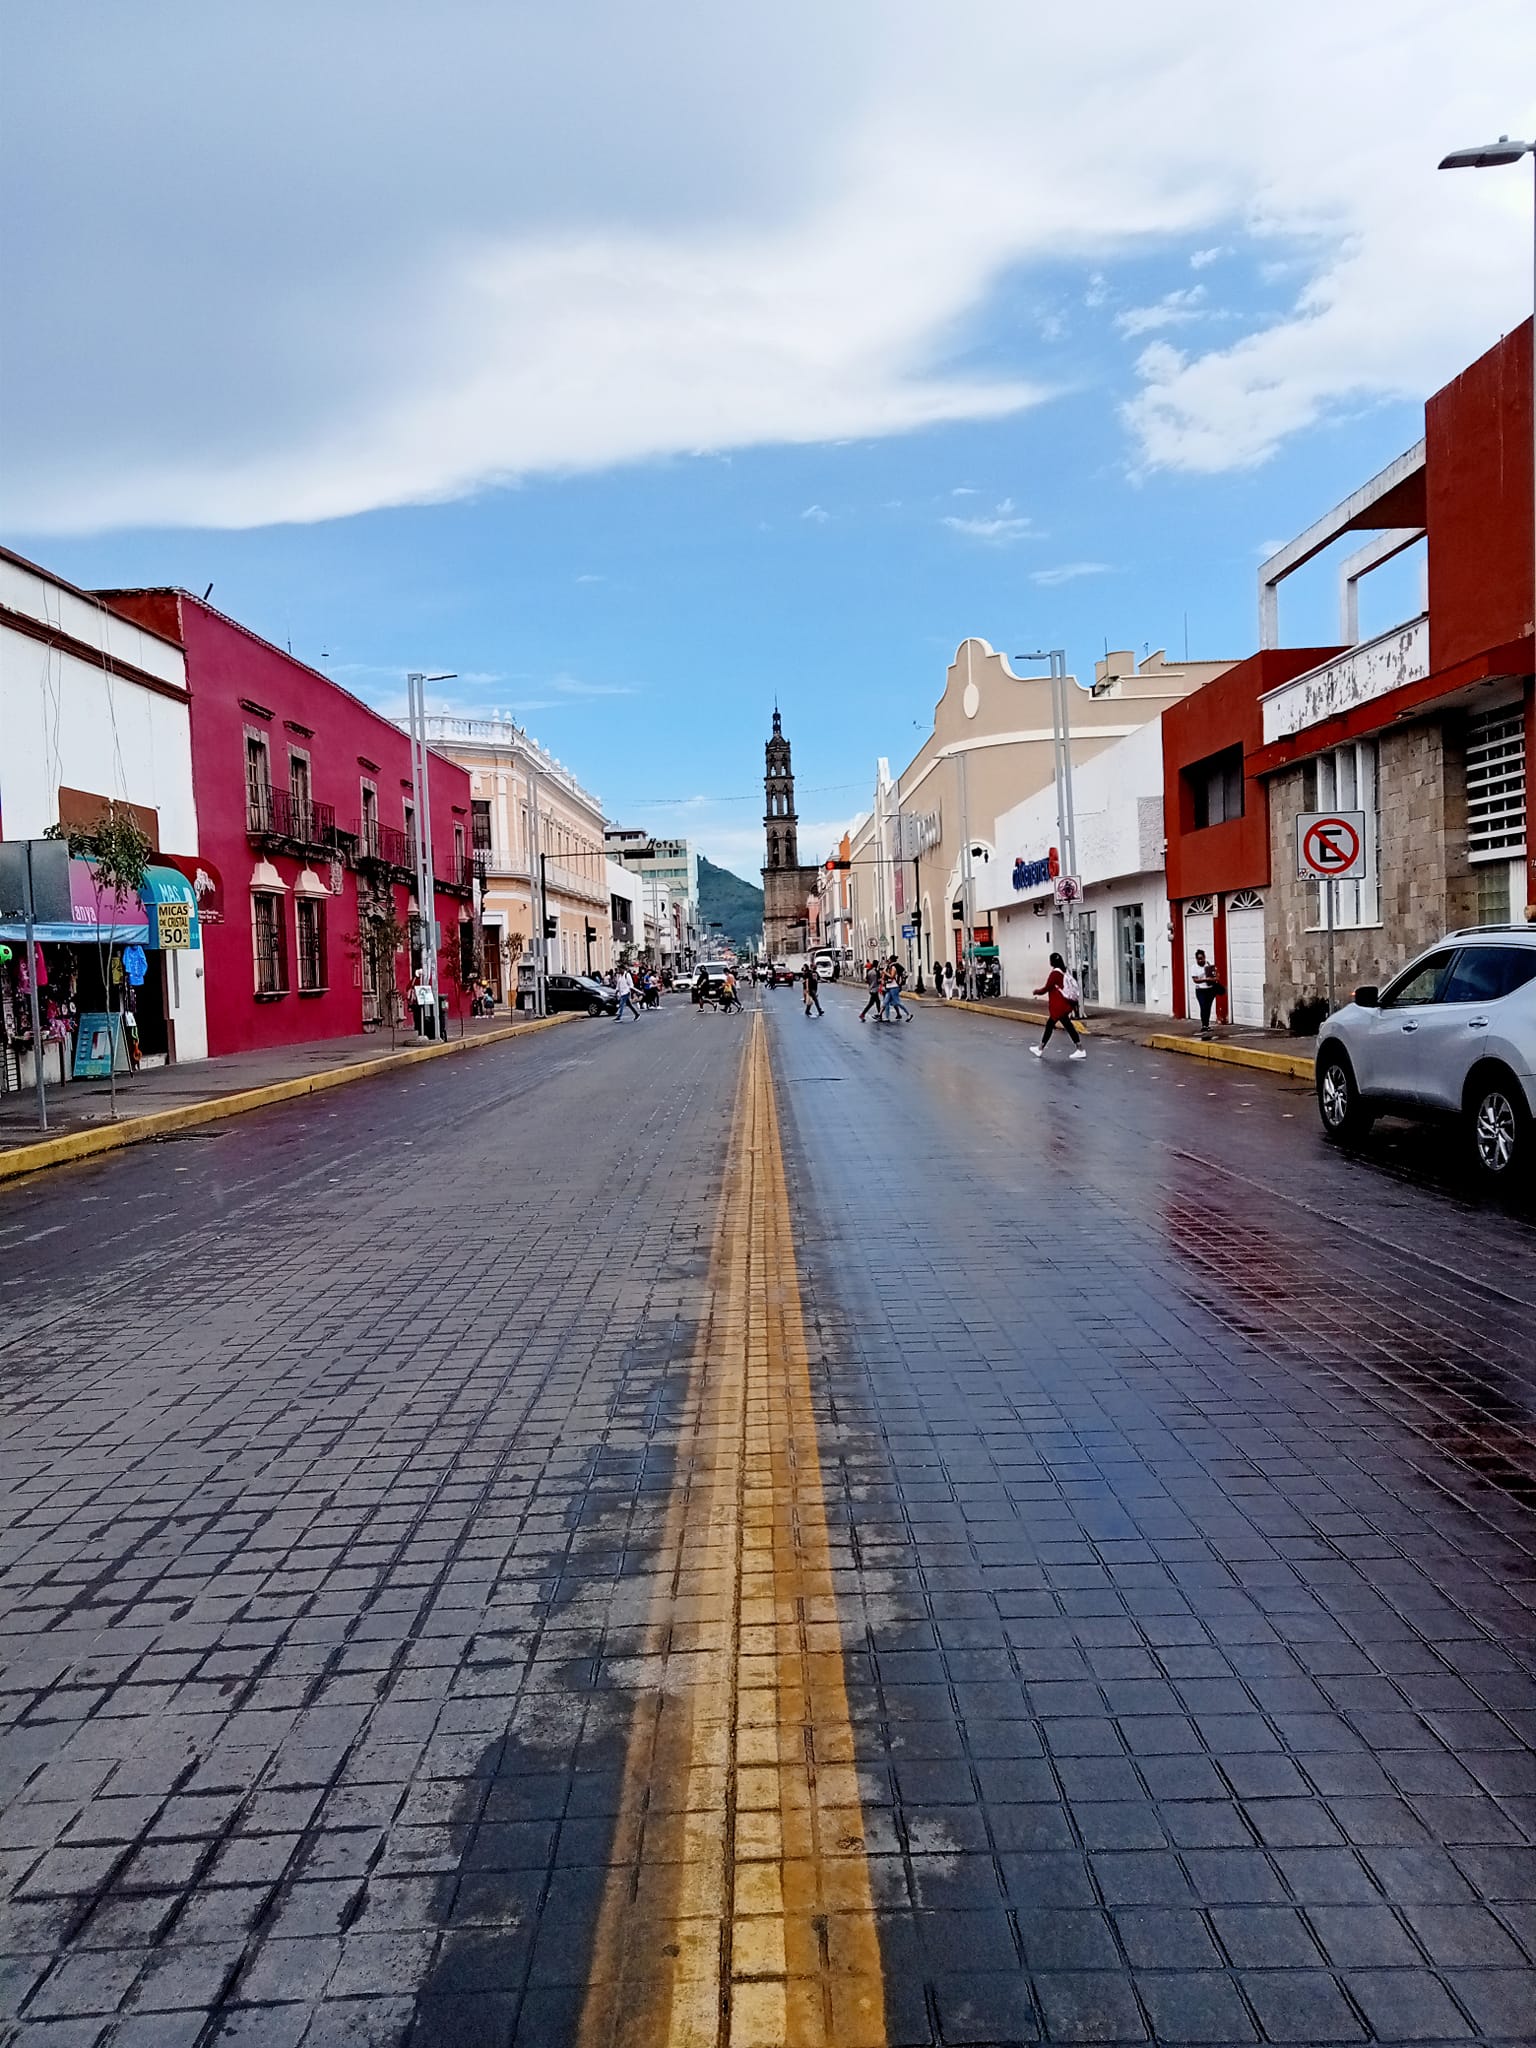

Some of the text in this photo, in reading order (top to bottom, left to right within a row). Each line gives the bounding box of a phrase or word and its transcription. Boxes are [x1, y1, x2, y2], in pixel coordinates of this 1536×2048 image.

[1319, 829, 1342, 863] E
[159, 906, 188, 916] MICAS
[167, 917, 188, 927] CRISTAL
